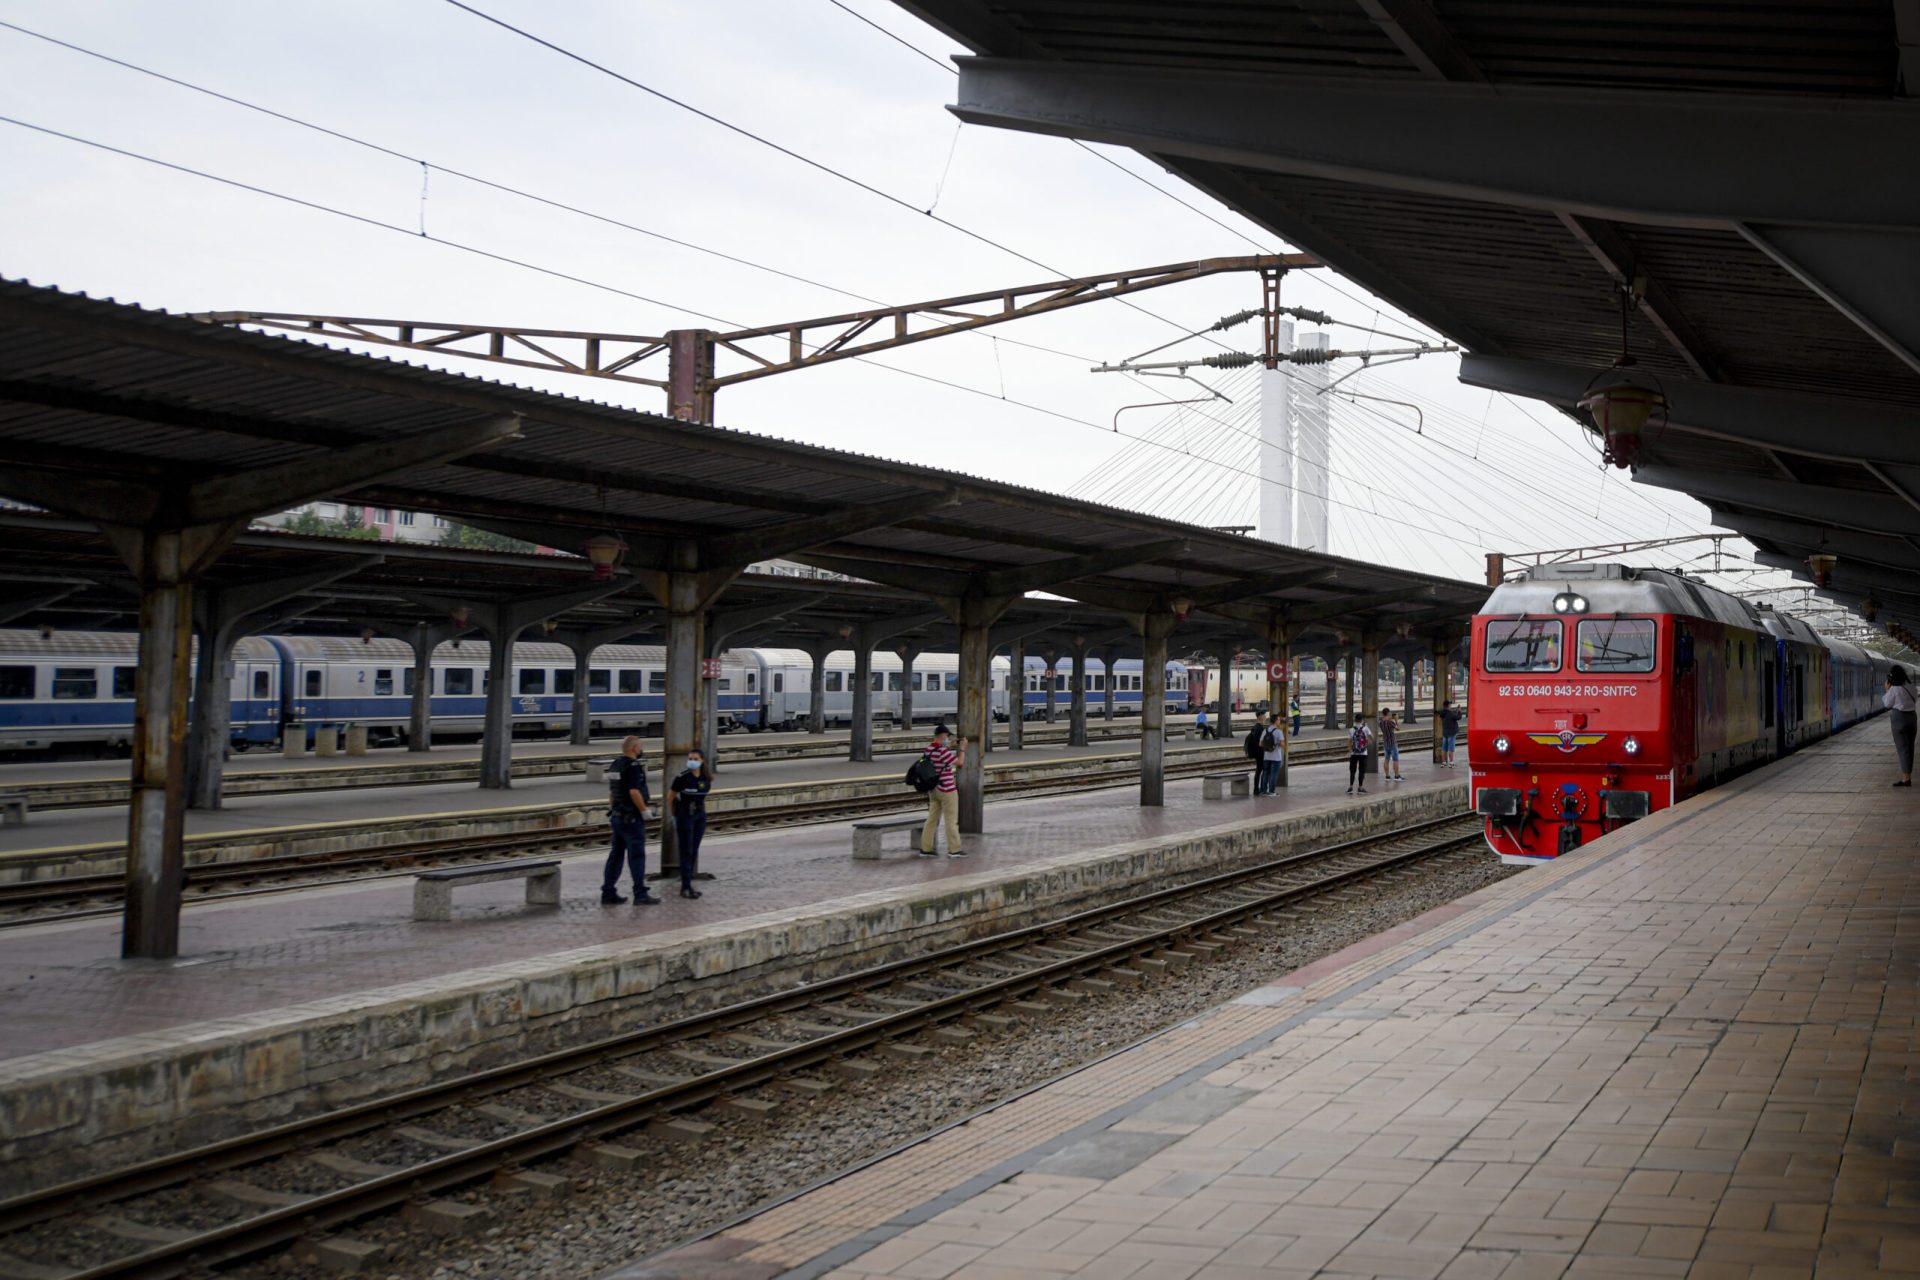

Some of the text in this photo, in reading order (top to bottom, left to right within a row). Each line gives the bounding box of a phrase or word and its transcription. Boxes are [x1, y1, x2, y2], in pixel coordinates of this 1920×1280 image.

[358, 671, 365, 683] 2
[1271, 664, 1283, 679] C
[1499, 685, 1637, 696] 92 53 0640 943-2 RO-SNTFC
